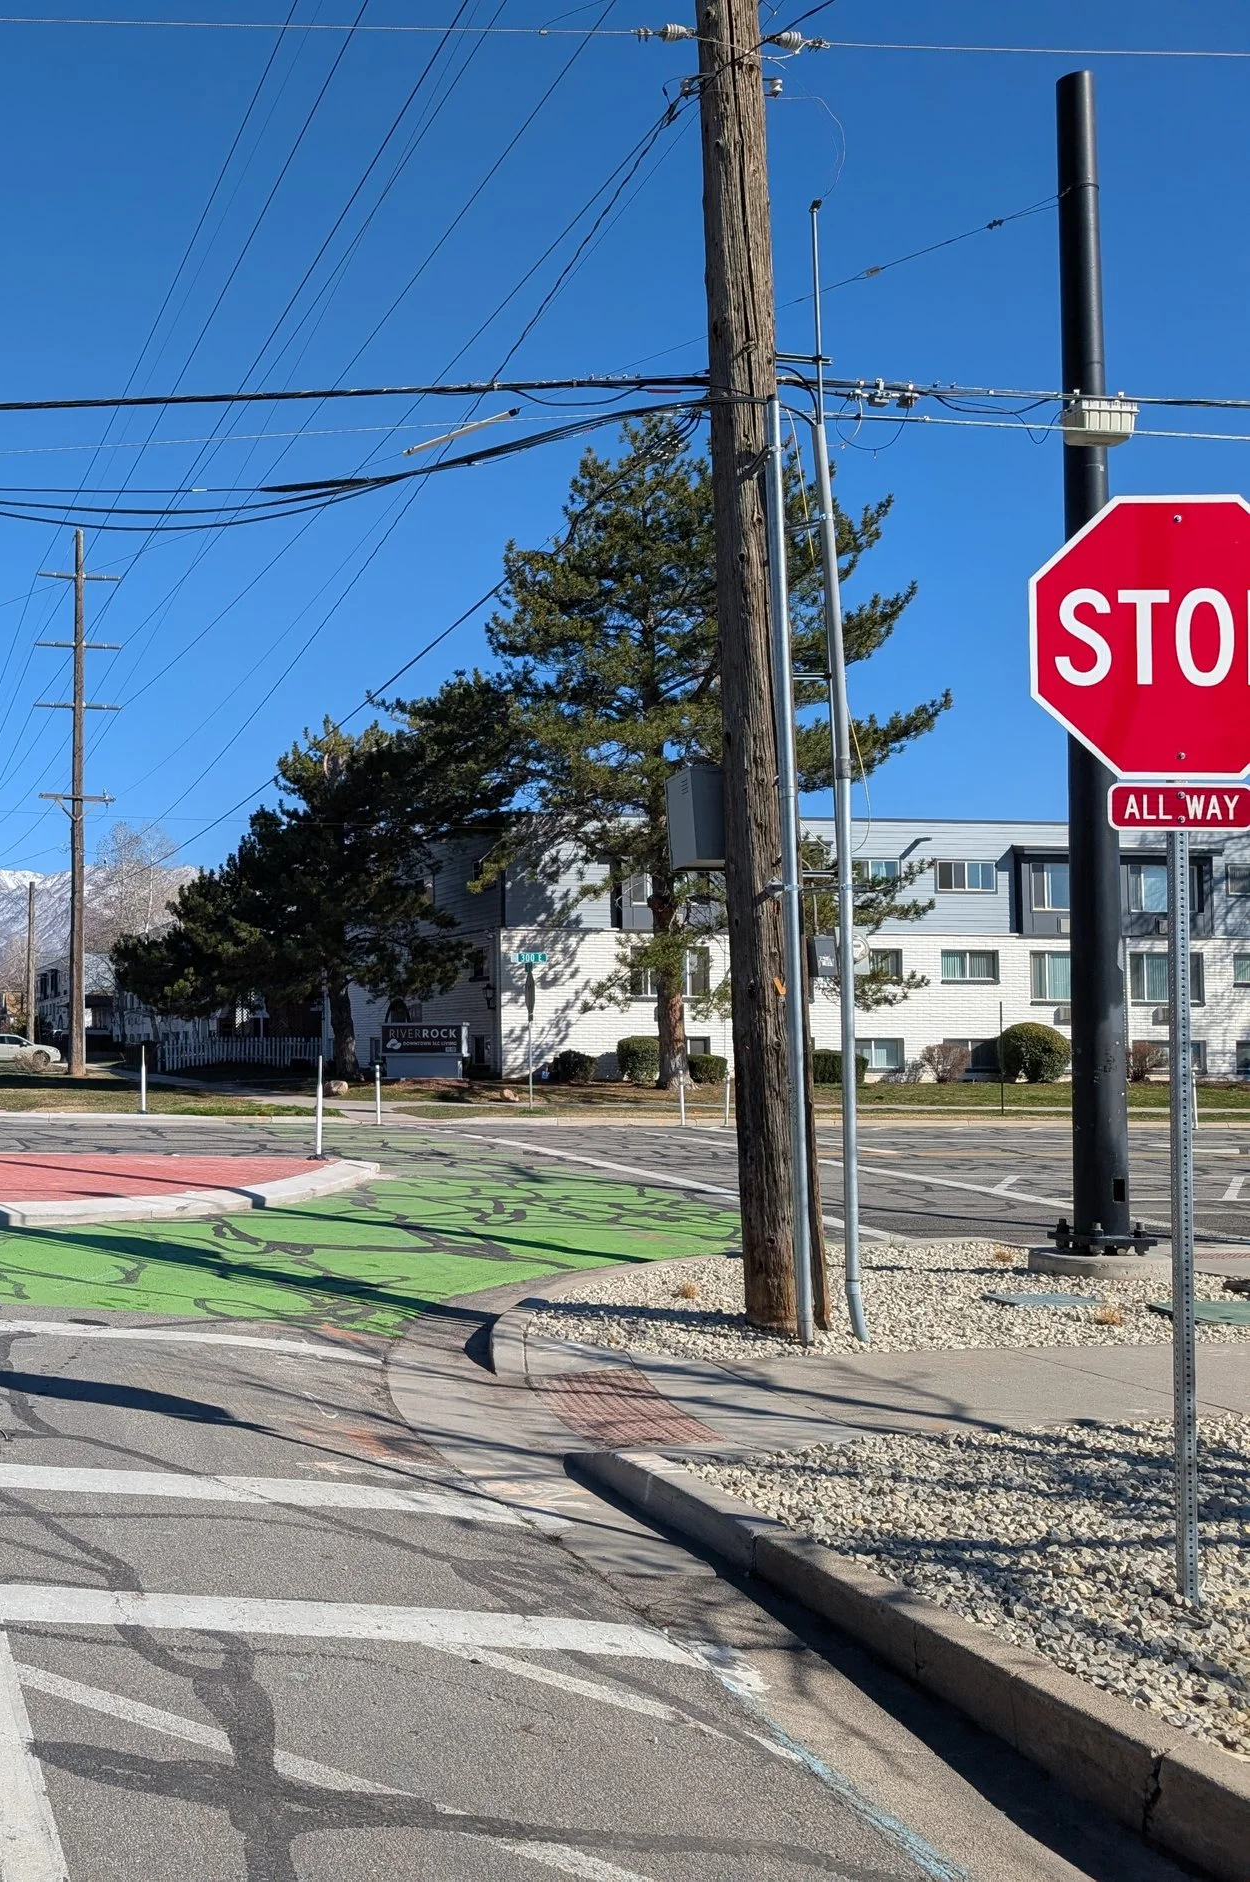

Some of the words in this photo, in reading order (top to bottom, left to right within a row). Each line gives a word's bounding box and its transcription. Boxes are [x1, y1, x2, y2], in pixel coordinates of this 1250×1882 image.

[1054, 587, 1250, 687] STO
[1124, 794, 1172, 820] ALL
[1185, 794, 1239, 820] WAY
[521, 953, 535, 961] 300
[389, 1028, 457, 1039] RIVERROCK
